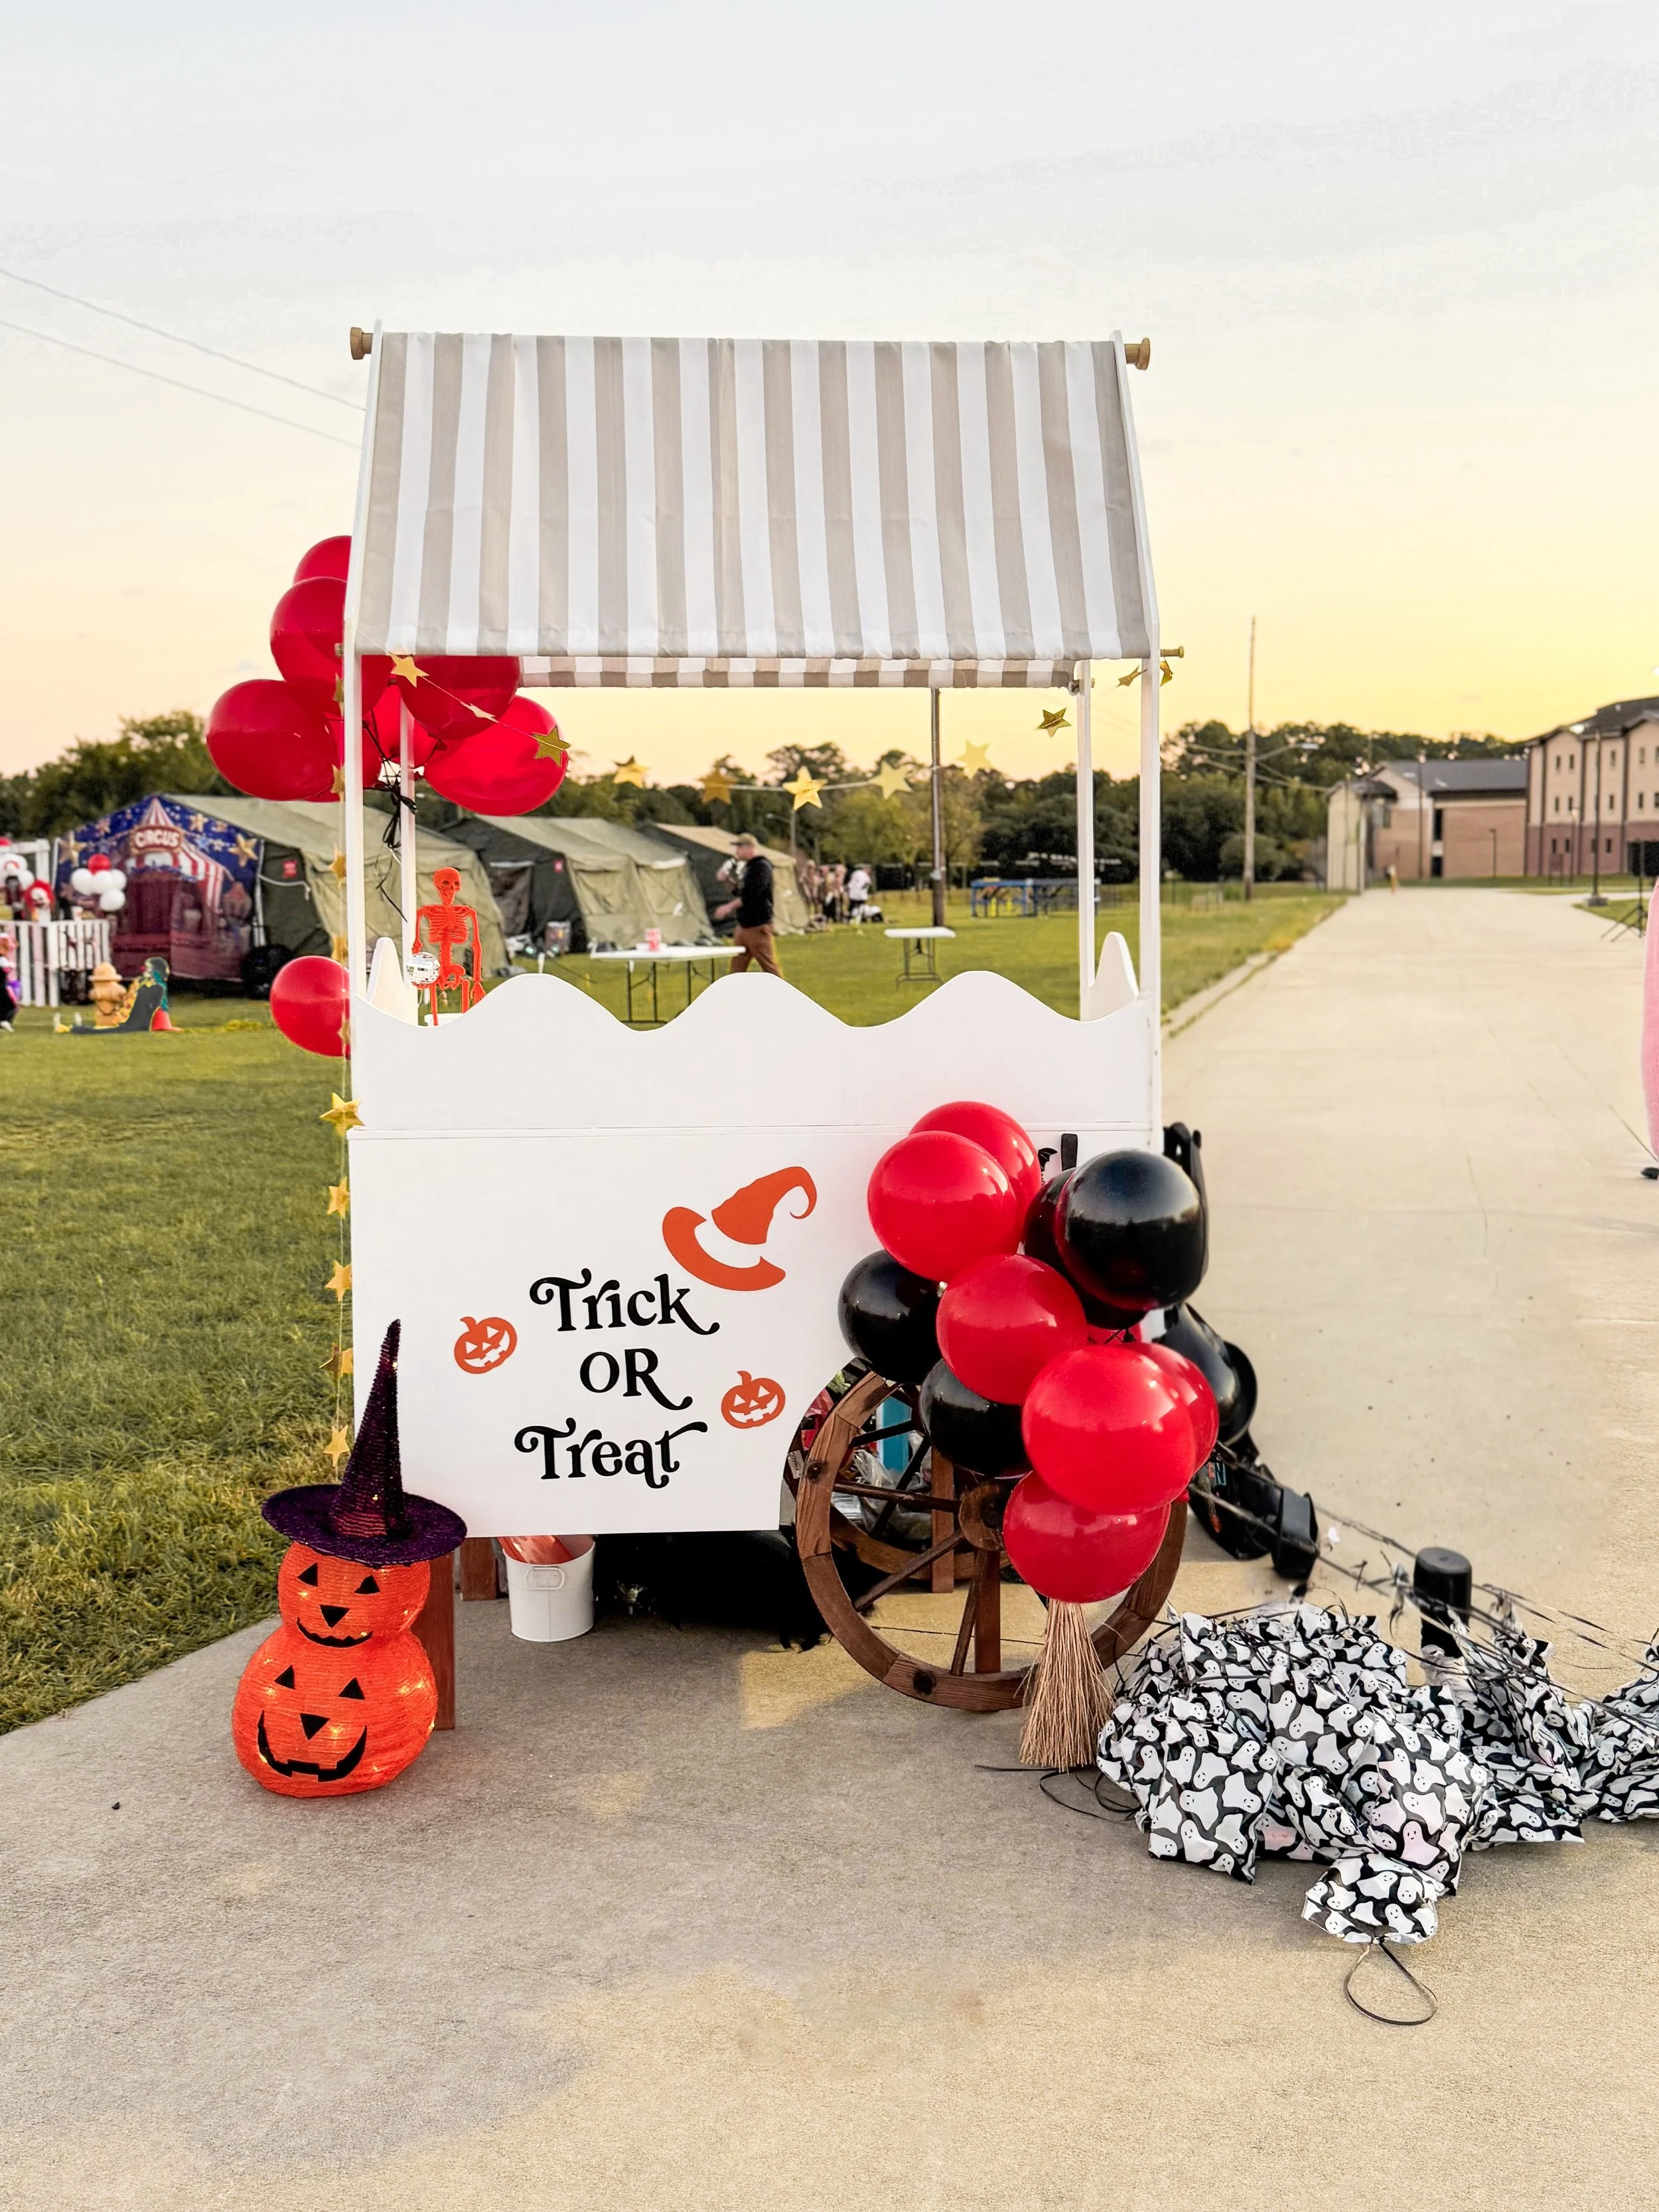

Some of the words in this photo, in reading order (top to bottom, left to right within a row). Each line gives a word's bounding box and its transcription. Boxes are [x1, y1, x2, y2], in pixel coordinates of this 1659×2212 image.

[135, 829, 179, 848] CIRCUS
[530, 1268, 720, 1335] Trick
[579, 1347, 693, 1410] OR
[514, 1417, 708, 1489] Treat
